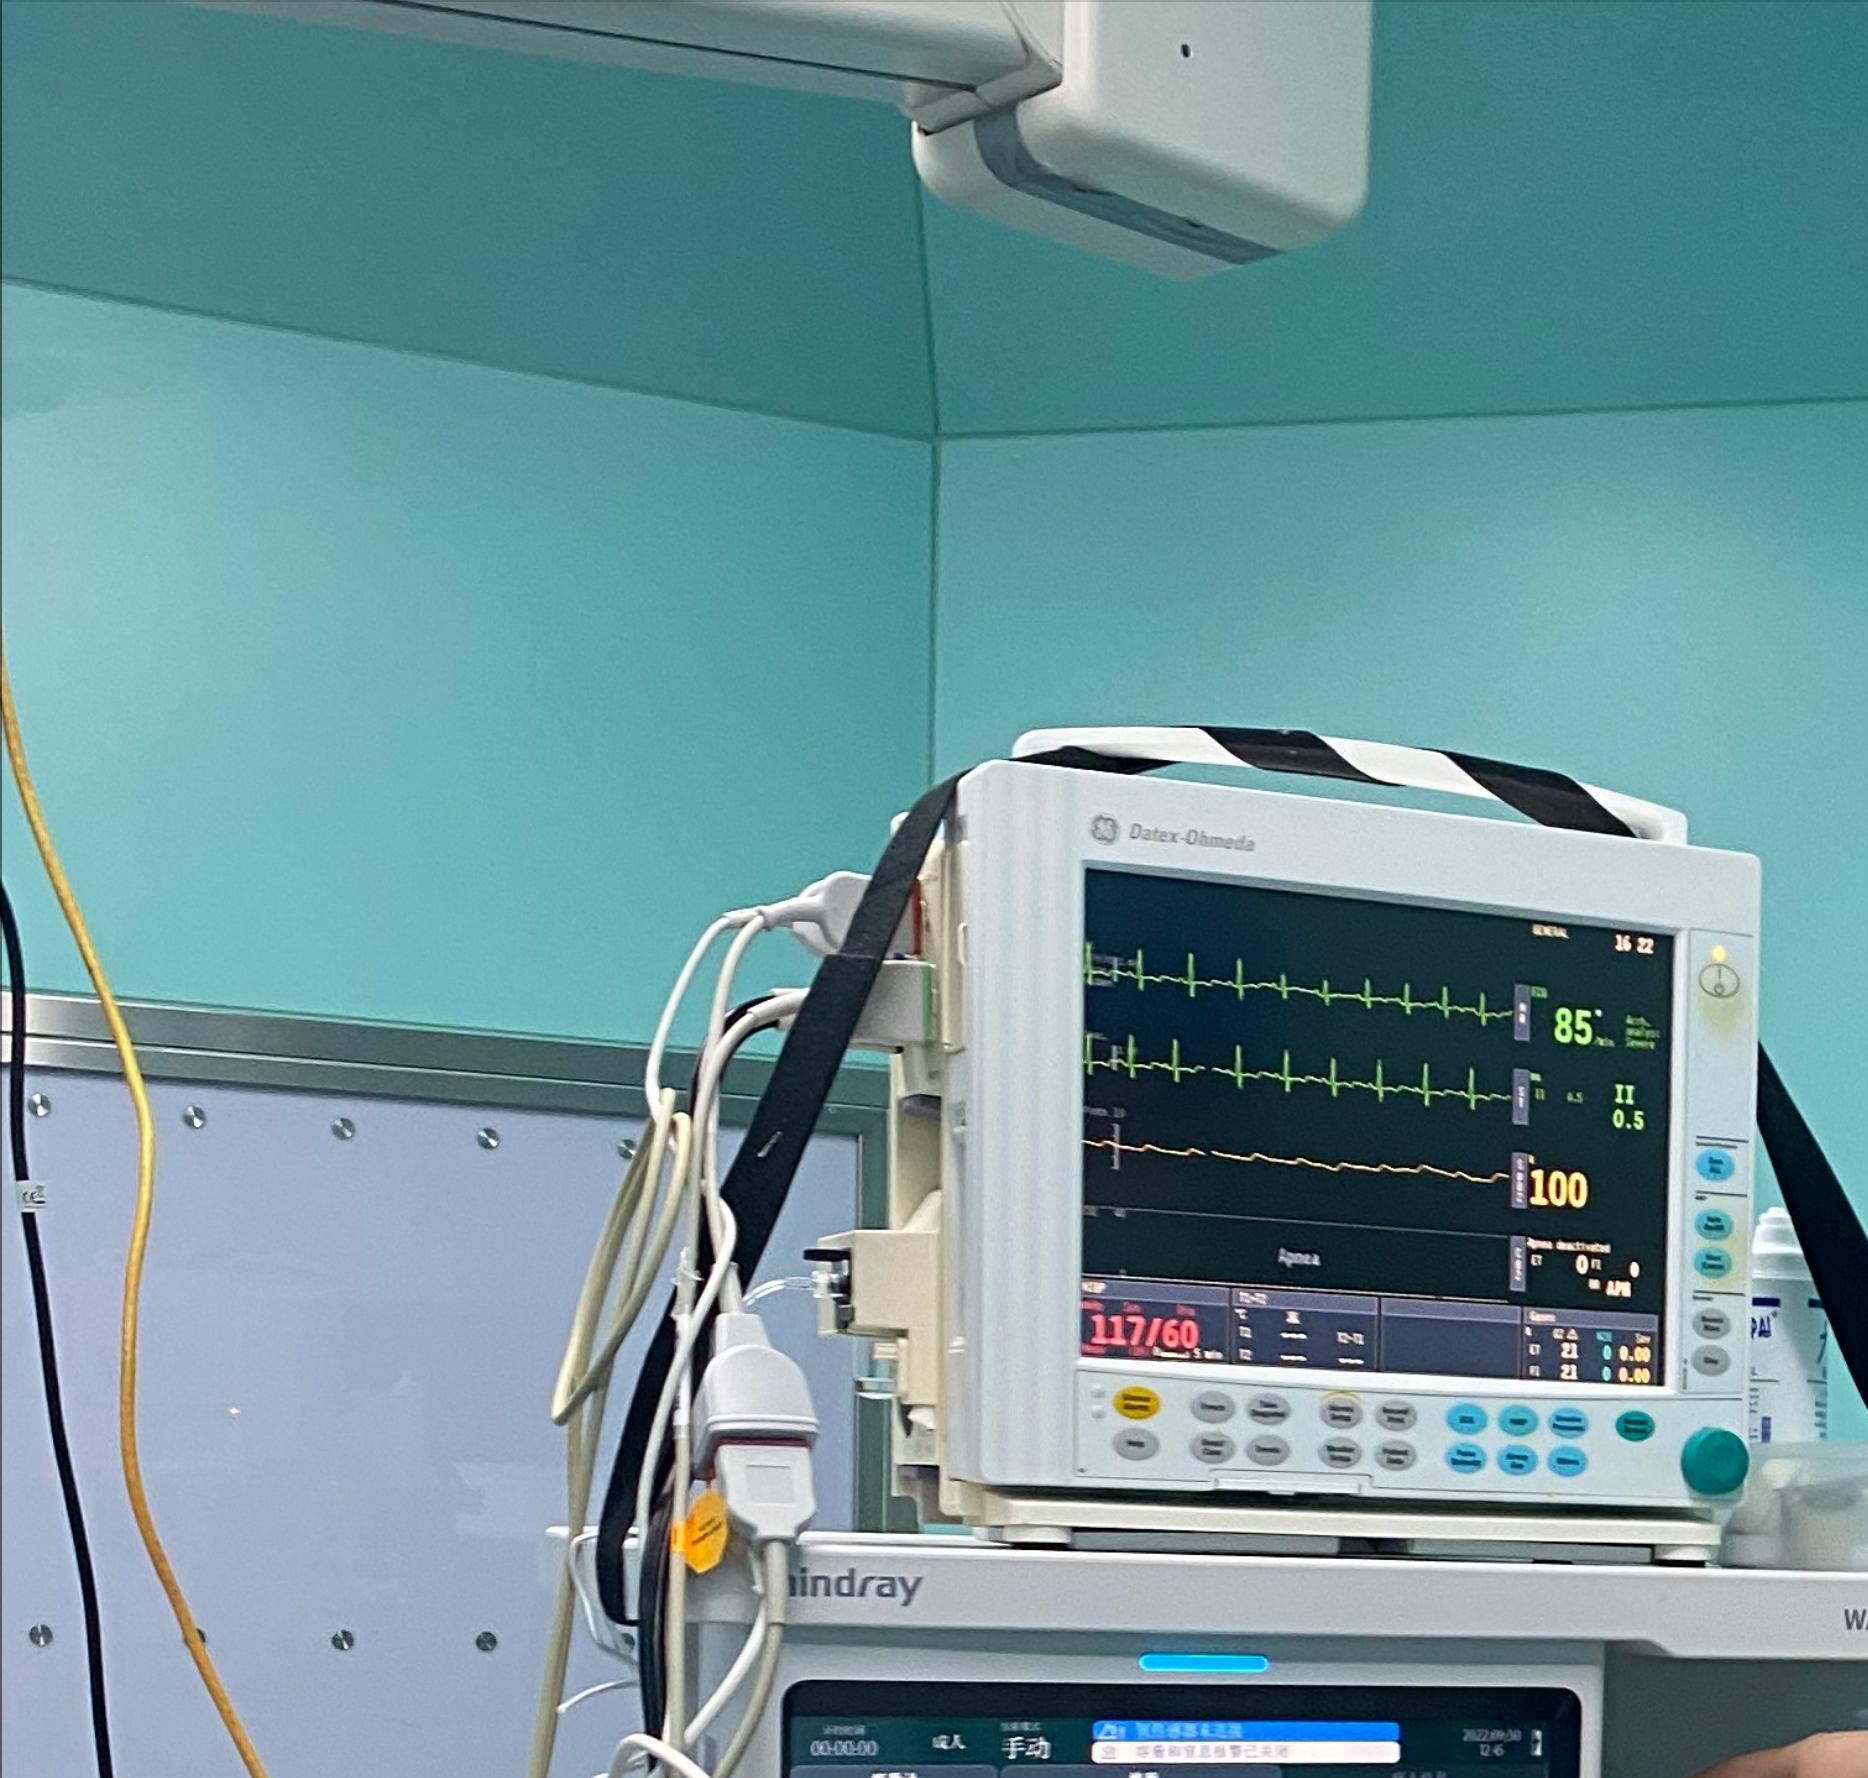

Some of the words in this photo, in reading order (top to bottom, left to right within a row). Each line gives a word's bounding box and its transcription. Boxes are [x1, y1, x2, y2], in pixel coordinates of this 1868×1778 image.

[1129, 822, 1255, 852] Datex-Ohmeda
[1554, 1007, 1593, 1045] 85
[1612, 1109, 1645, 1130] 0.5
[1530, 1169, 1588, 1208] 100
[1091, 1314, 1199, 1349] 117/60
[931, 1734, 967, 1750] 成人
[1002, 1736, 1051, 1760] 手动
